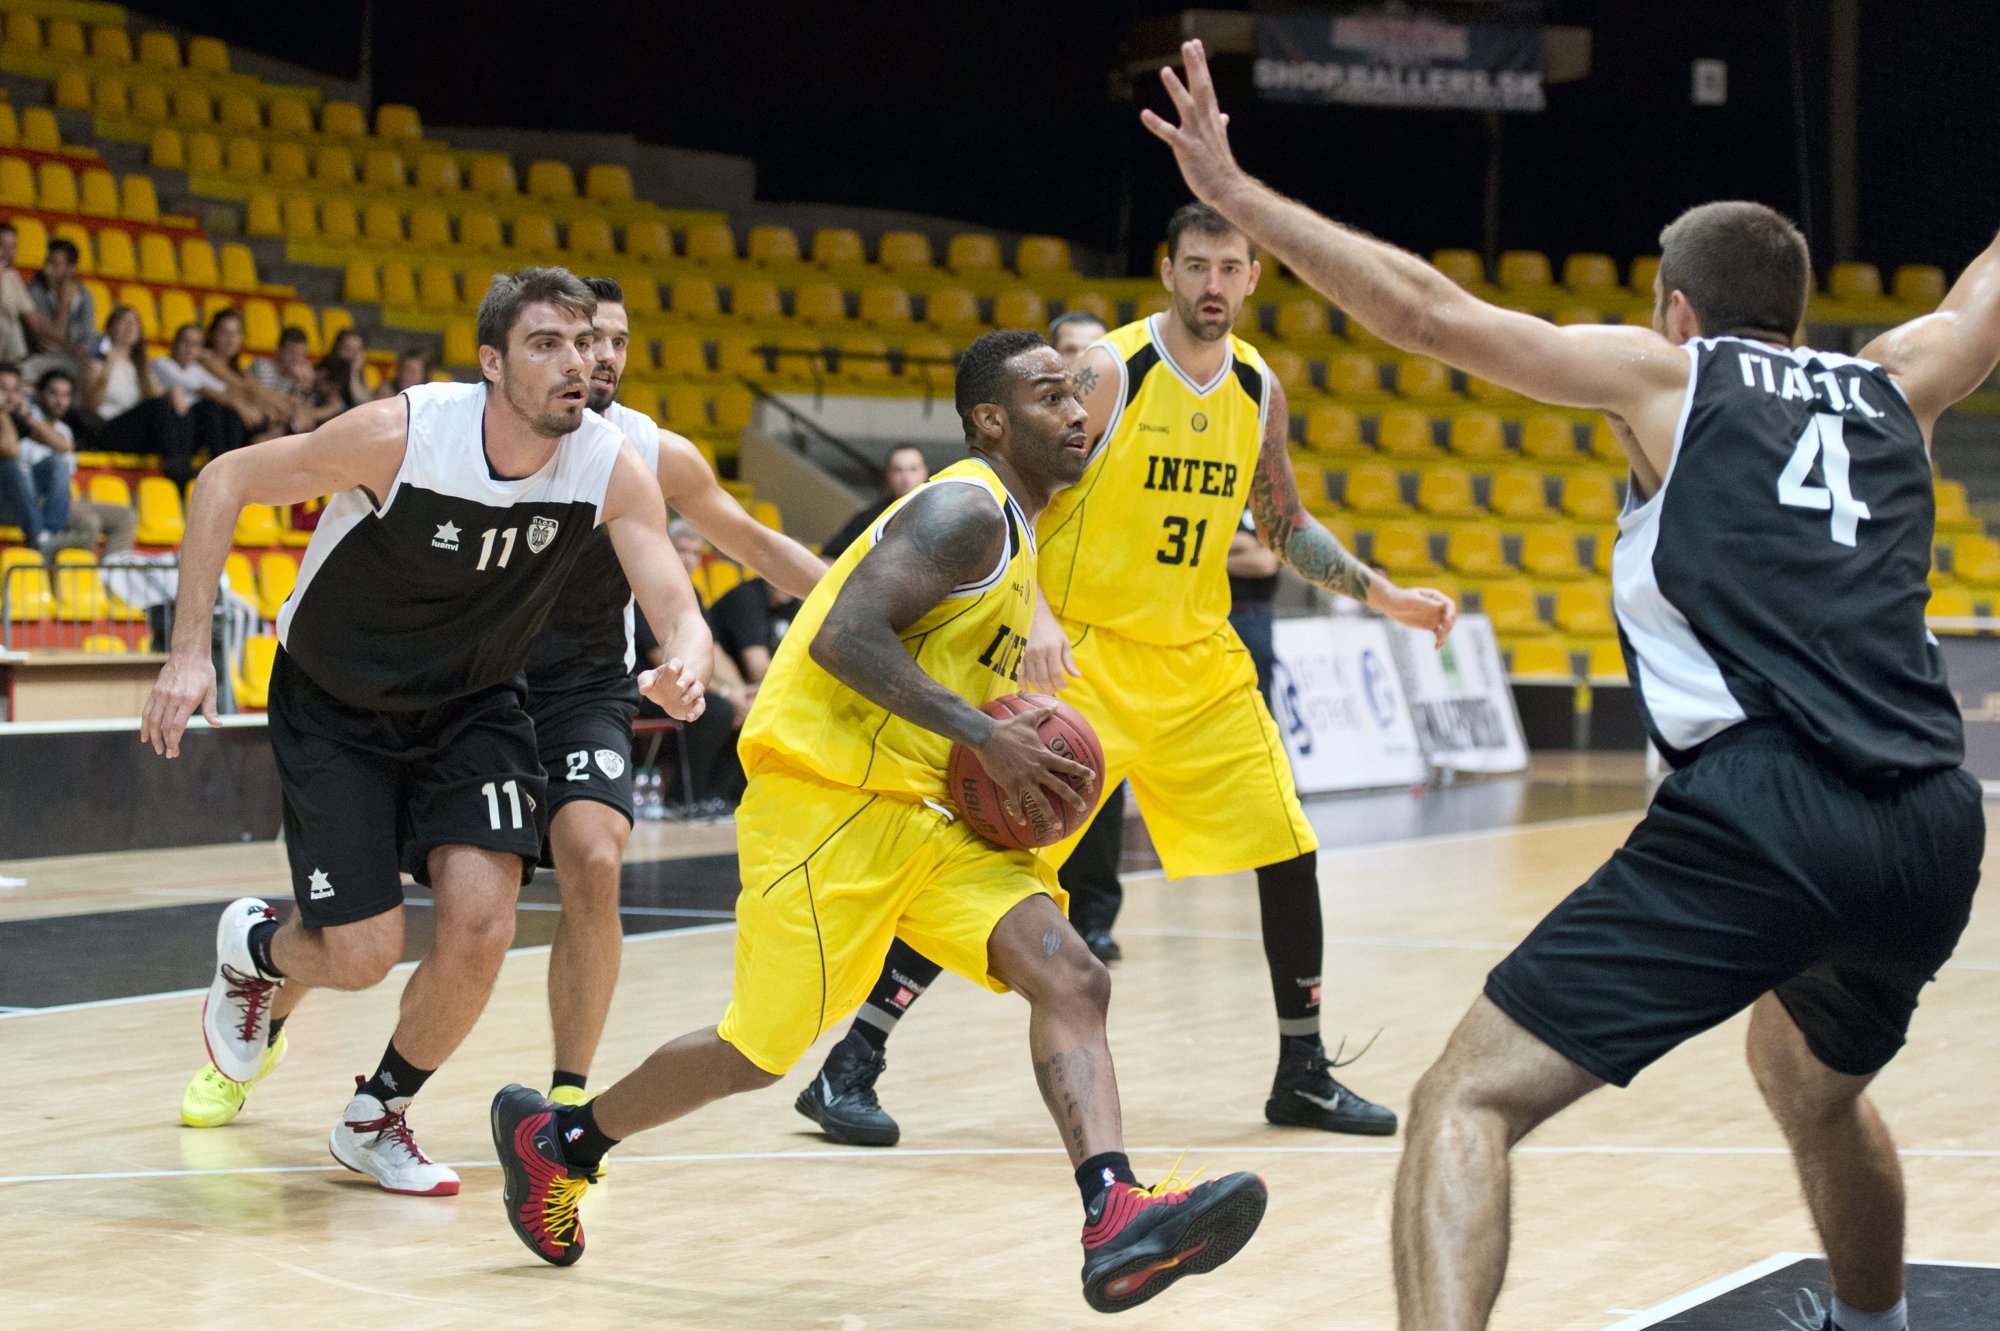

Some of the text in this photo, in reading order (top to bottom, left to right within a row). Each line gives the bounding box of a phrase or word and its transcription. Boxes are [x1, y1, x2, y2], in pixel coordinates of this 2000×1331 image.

[1143, 455, 1238, 498] INTER
[1777, 412, 1872, 548] 4
[431, 539, 459, 552] luanvi
[476, 527, 518, 571] 11
[1156, 515, 1208, 567] 31
[566, 750, 590, 782] 2
[481, 780, 523, 831] 11
